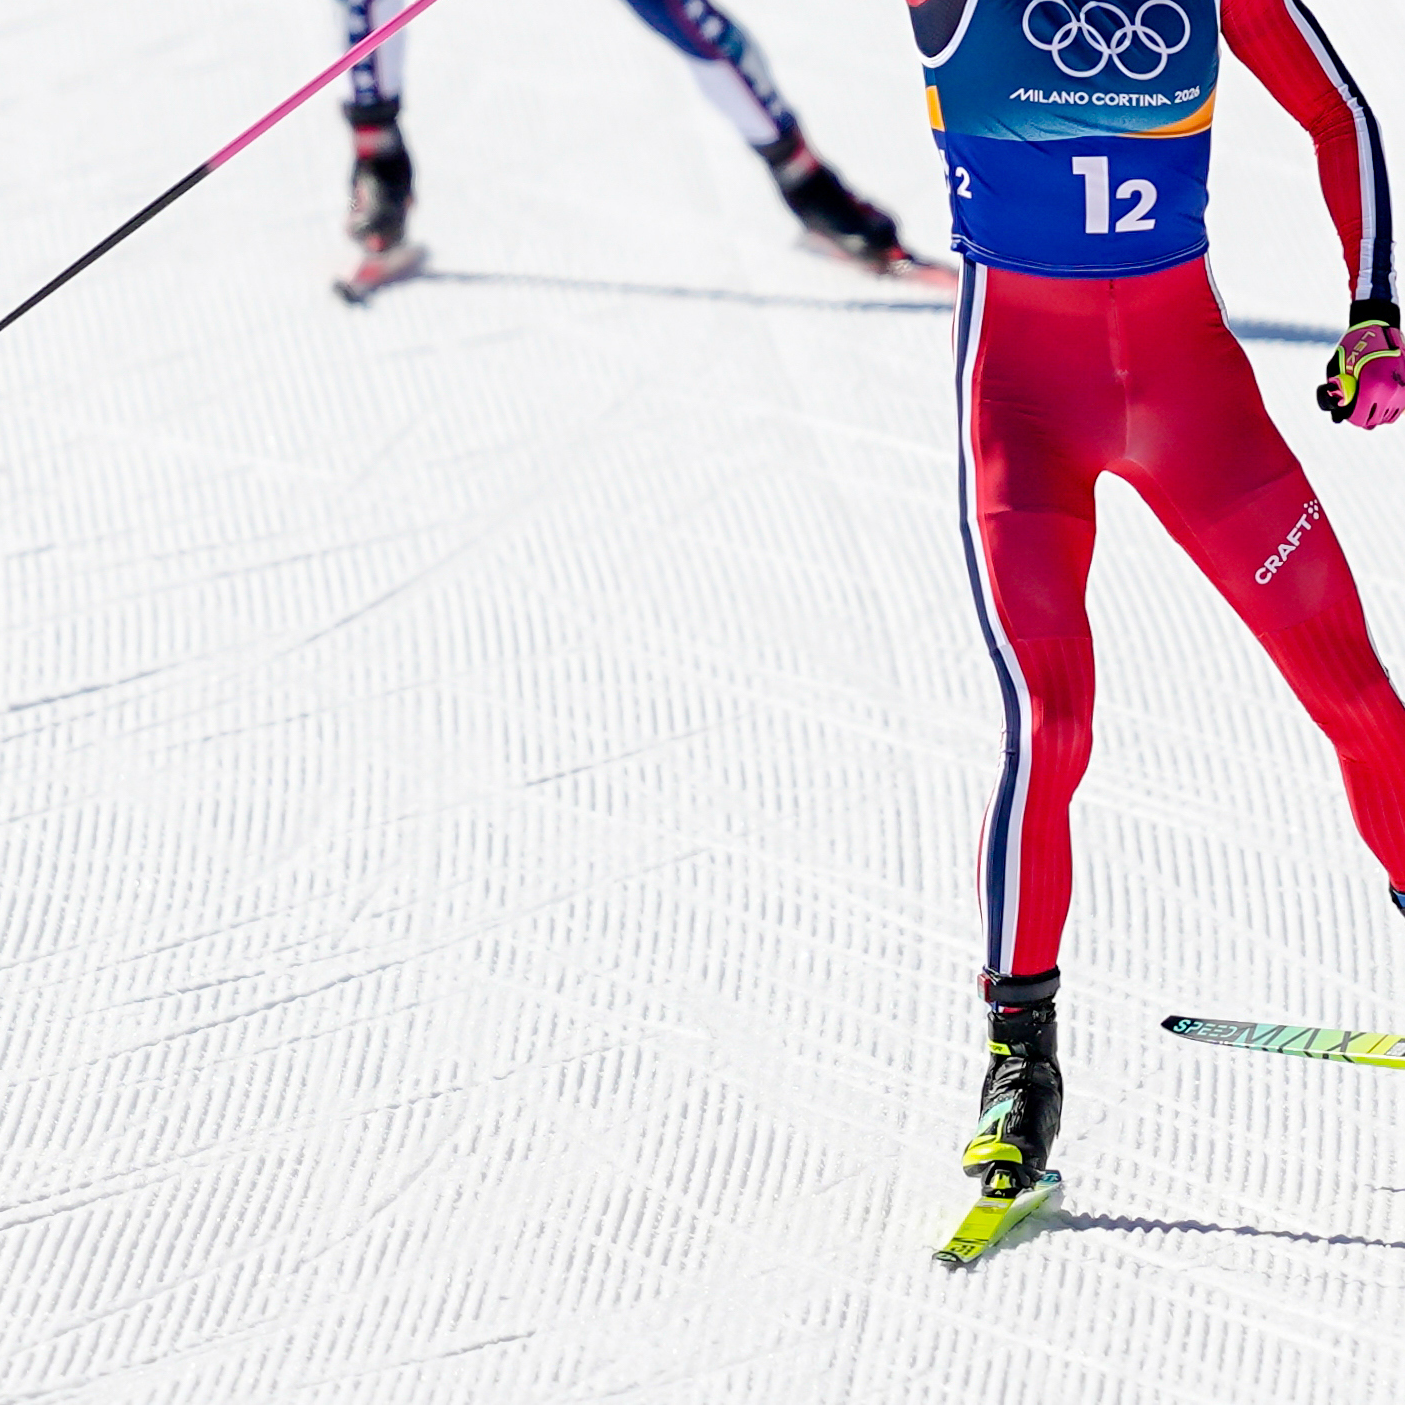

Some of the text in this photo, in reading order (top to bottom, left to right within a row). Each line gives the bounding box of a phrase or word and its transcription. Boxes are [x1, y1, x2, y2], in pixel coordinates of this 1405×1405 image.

[1009, 86, 1200, 107] MILANO CORTINA 2026
[1255, 513, 1312, 585] CRAFT
